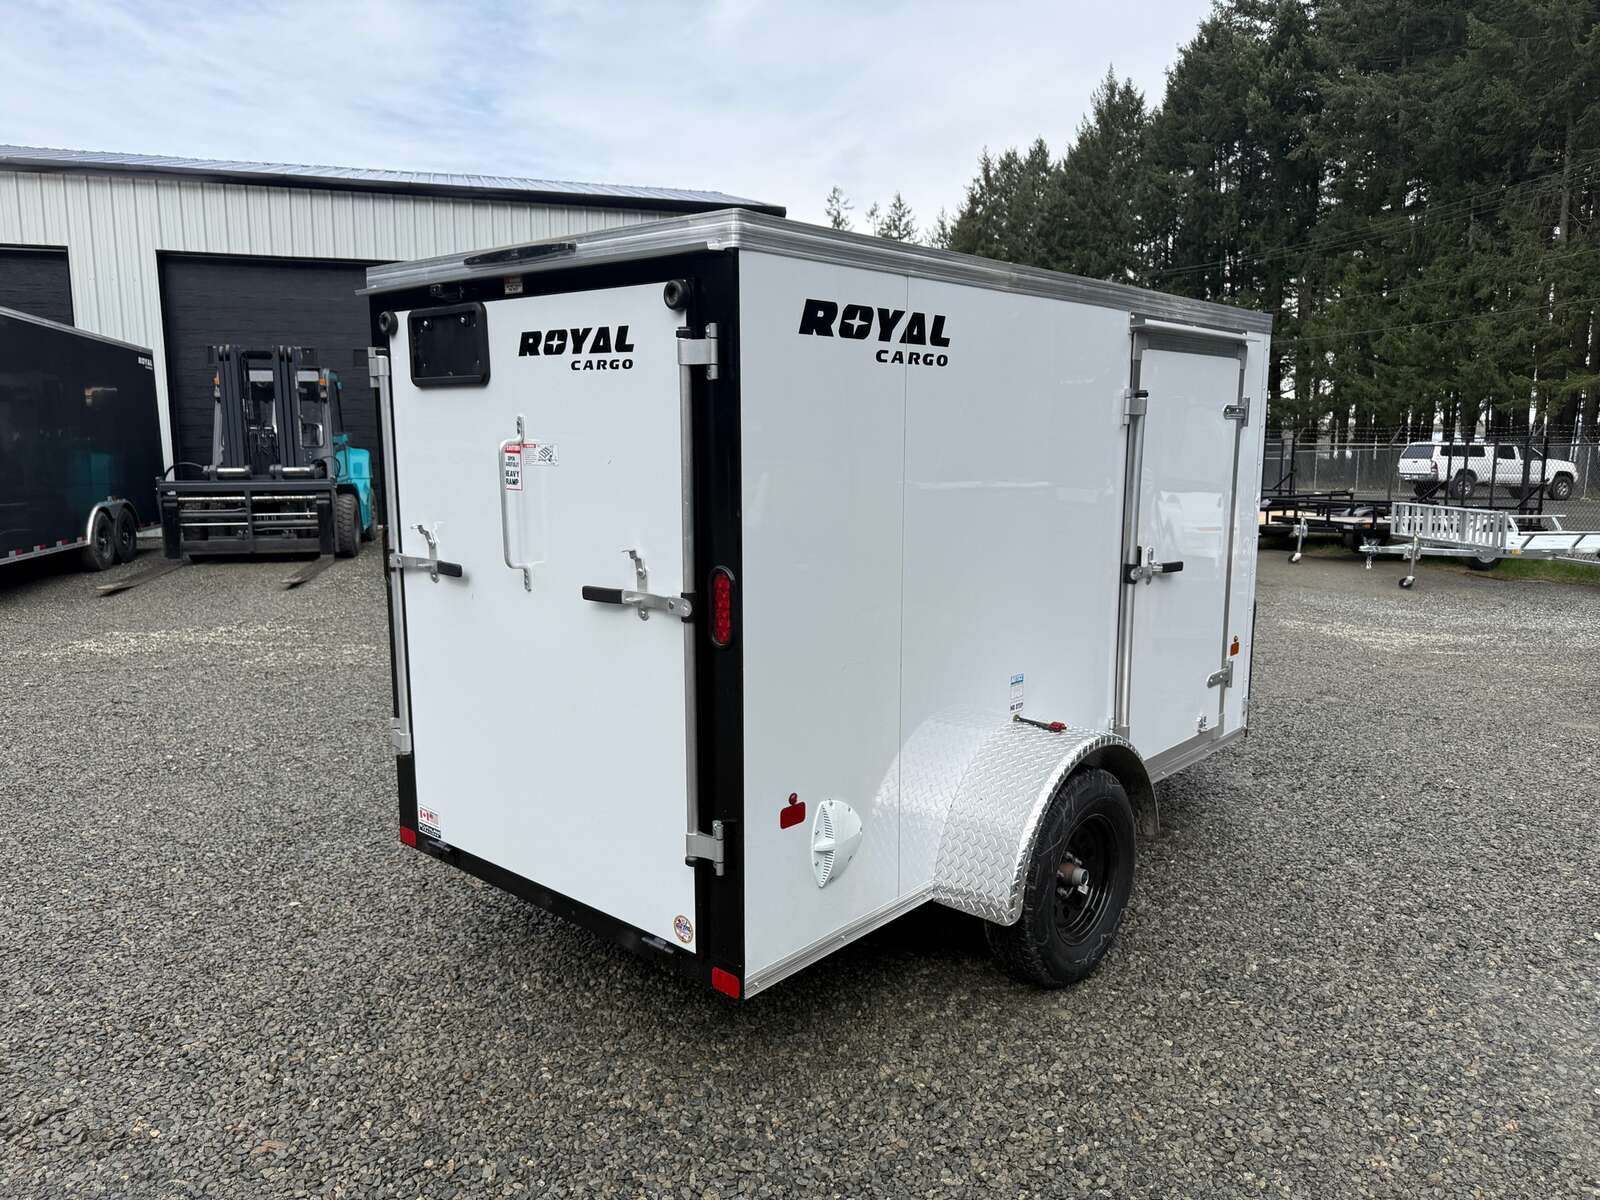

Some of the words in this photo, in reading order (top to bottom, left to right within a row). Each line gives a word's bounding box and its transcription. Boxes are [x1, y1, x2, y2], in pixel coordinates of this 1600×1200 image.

[798, 298, 951, 348] ROYAL
[518, 324, 635, 357] ROYAL
[570, 358, 634, 371] CARGO
[875, 349, 949, 367] CARGO
